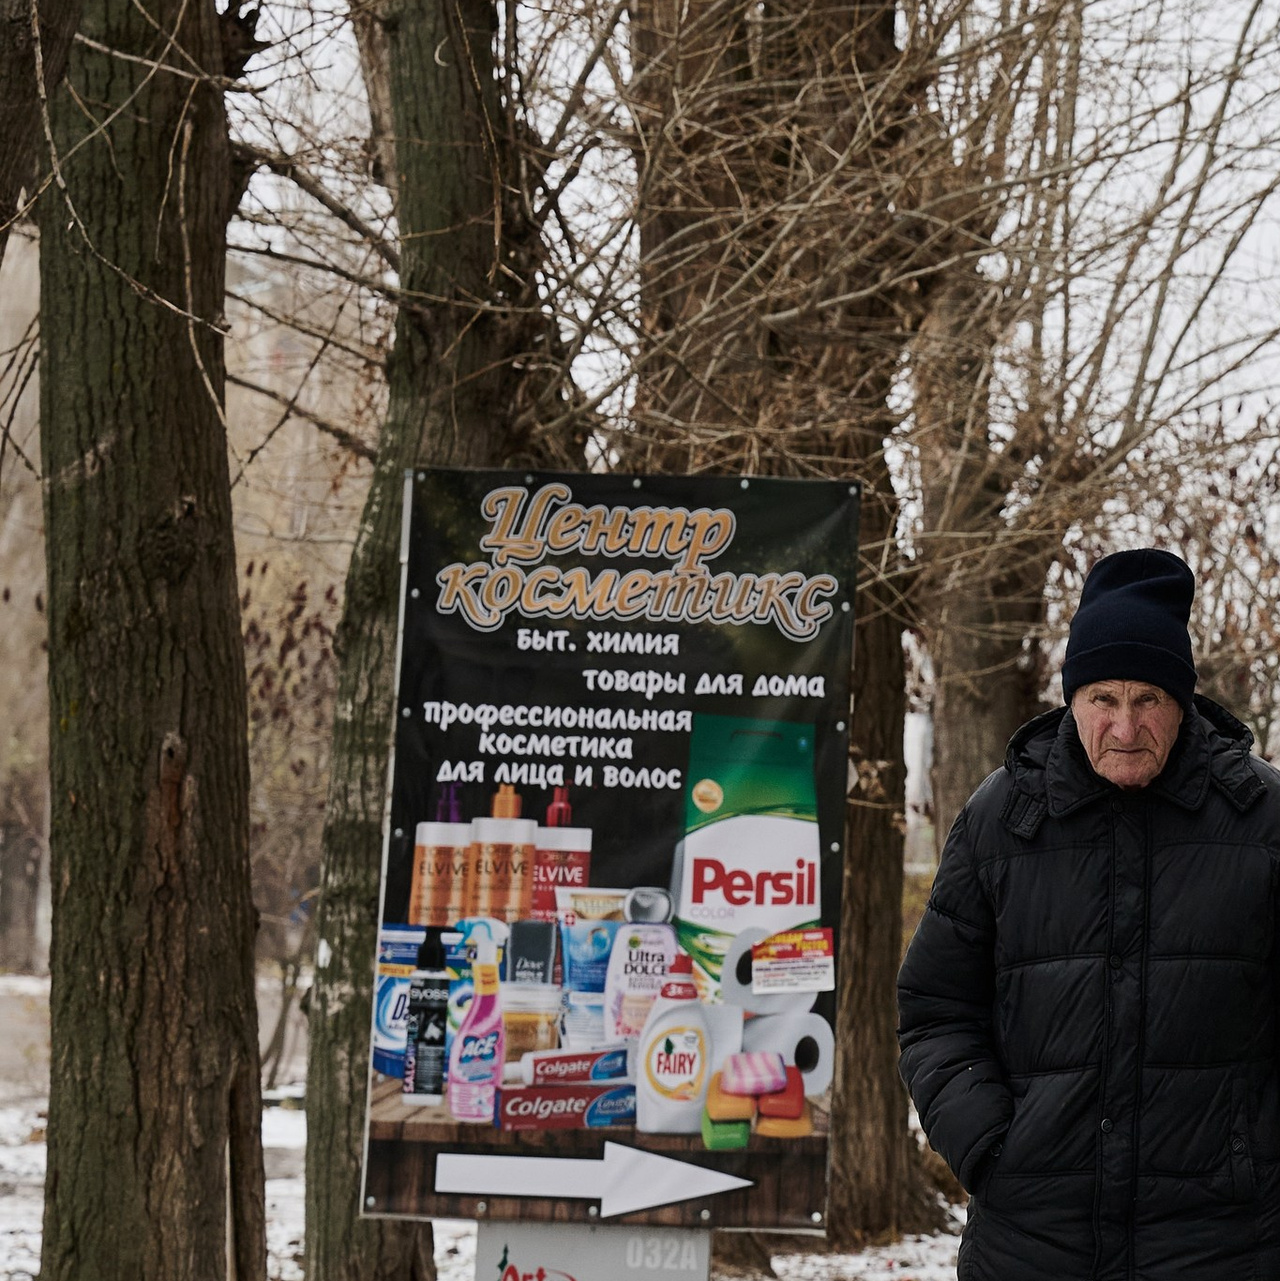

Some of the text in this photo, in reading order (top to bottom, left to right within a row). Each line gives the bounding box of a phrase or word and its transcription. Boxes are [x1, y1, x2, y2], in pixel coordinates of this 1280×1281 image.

[481, 483, 736, 574] Центр
[582, 669, 826, 700] товары для дома
[423, 701, 693, 732] профессиональная
[436, 759, 682, 790] для лица и волос
[419, 859, 469, 876] ELVIVE
[475, 859, 528, 874] ELVIVE
[533, 864, 583, 883] ELVIVE
[692, 858, 816, 906] Persil
[690, 906, 735, 919] COLOR
[628, 950, 664, 962] Ultra
[463, 1035, 497, 1058] ACE
[535, 1059, 591, 1076] Colgate
[656, 1052, 696, 1075] FAIRY
[505, 1096, 587, 1119] Colgate
